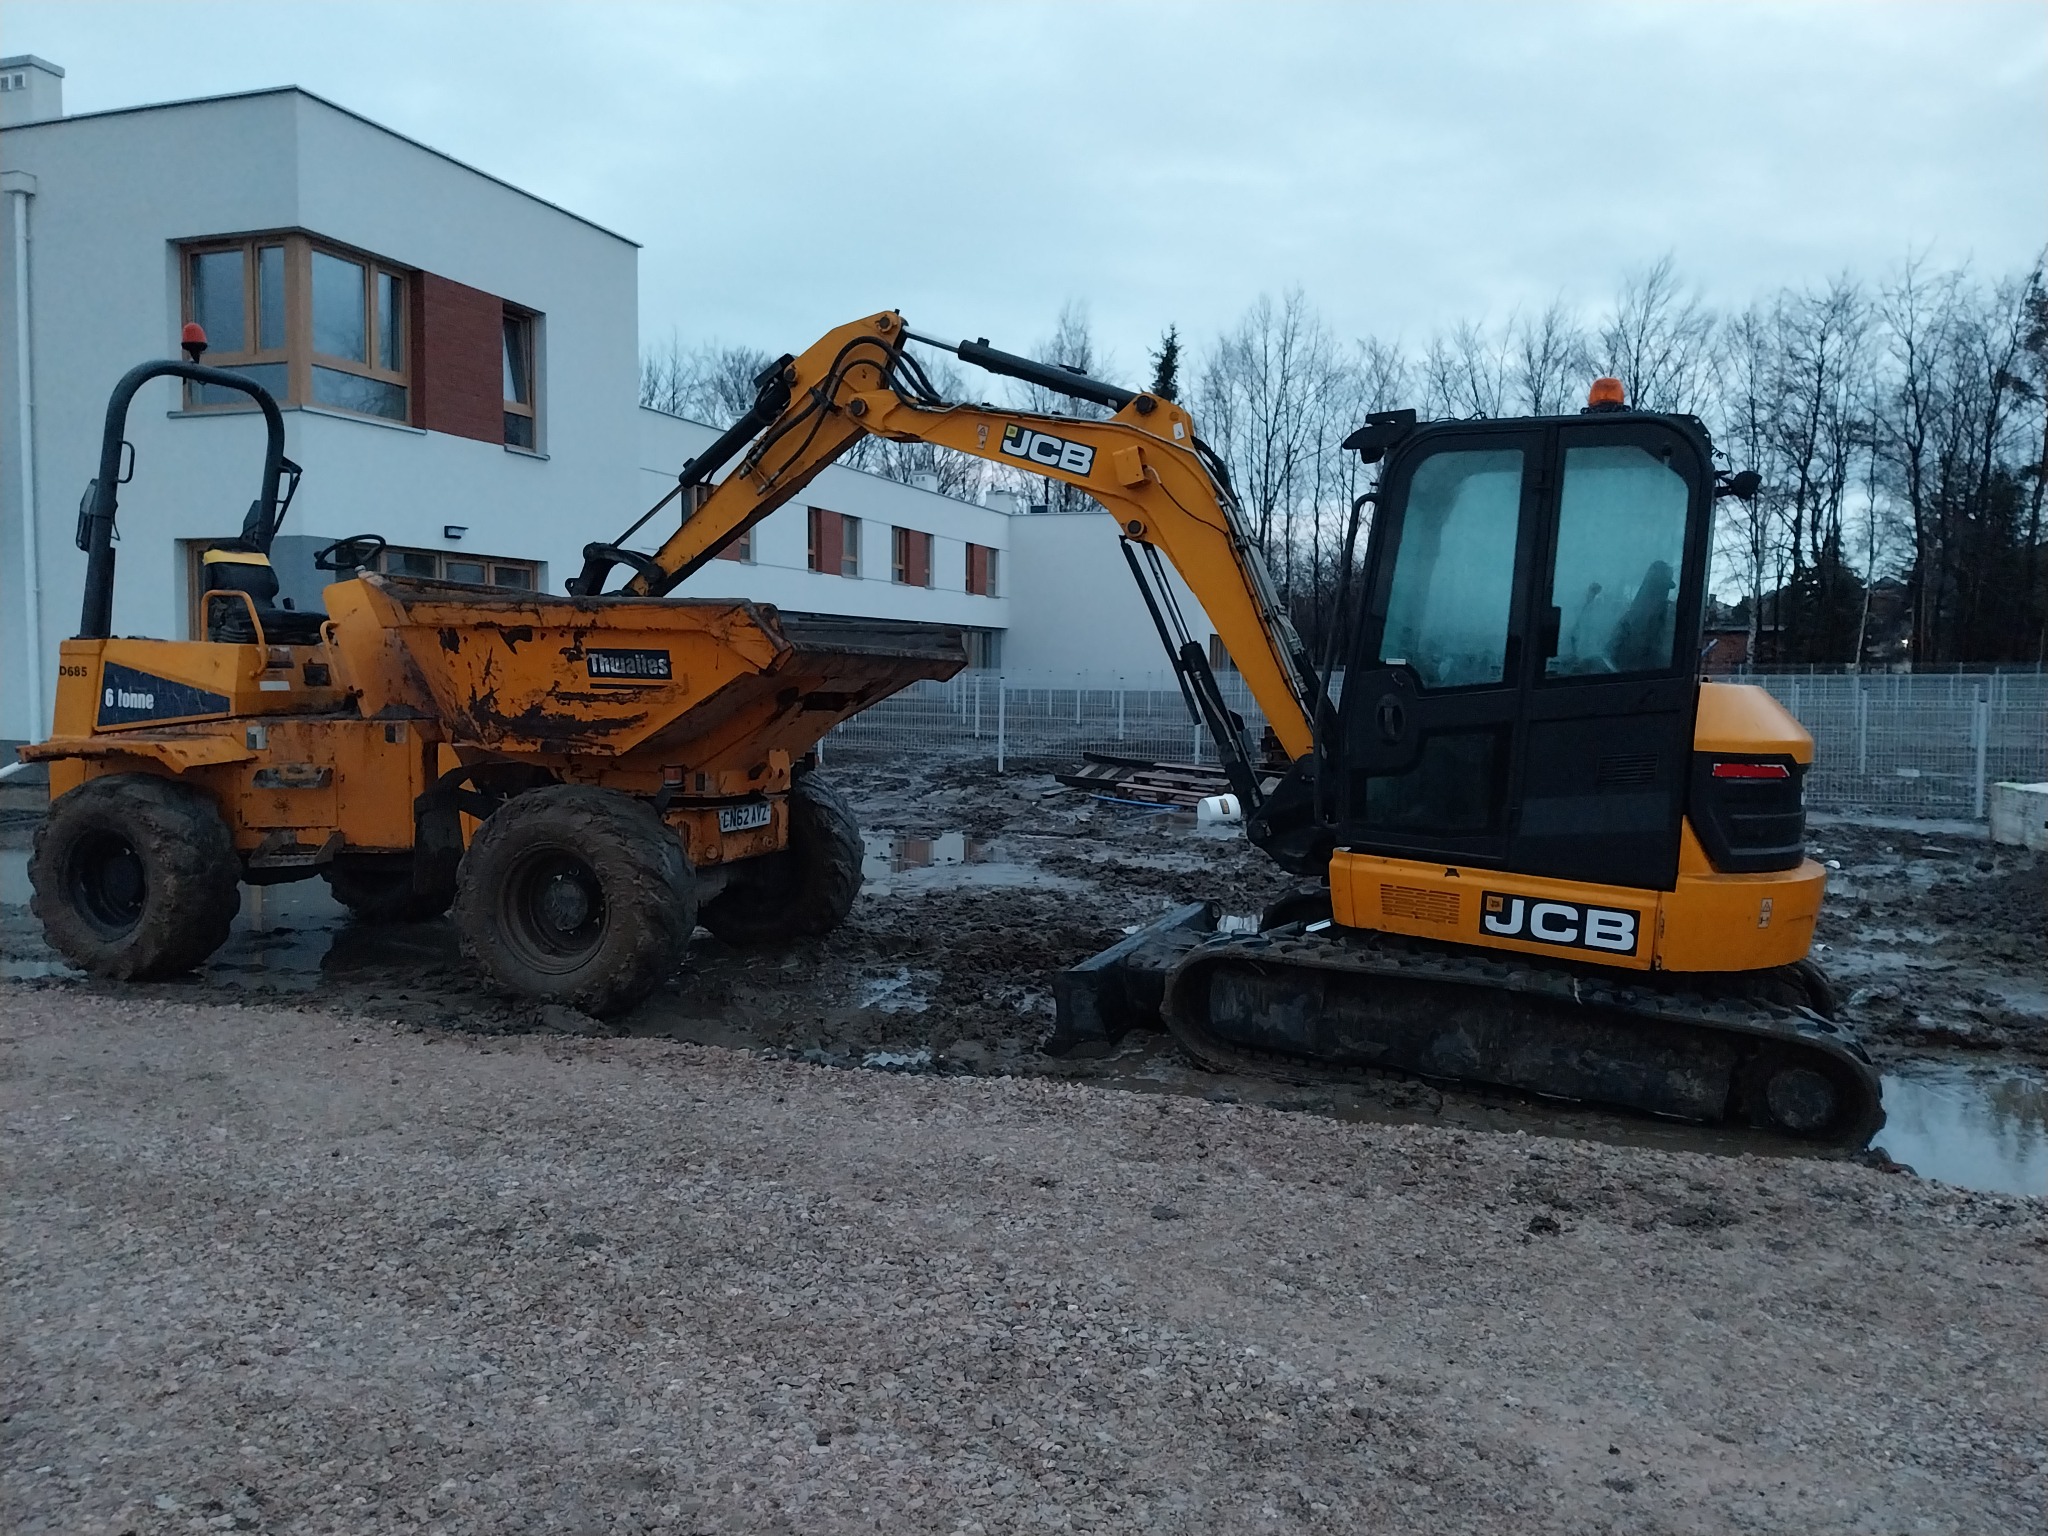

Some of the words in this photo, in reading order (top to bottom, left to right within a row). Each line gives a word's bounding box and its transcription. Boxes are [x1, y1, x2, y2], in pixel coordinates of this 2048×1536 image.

[1002, 430, 1093, 474] JCB
[59, 666, 87, 677] D685
[105, 688, 114, 707] 6
[118, 688, 154, 709] tonne
[1485, 899, 1635, 950] JCB
